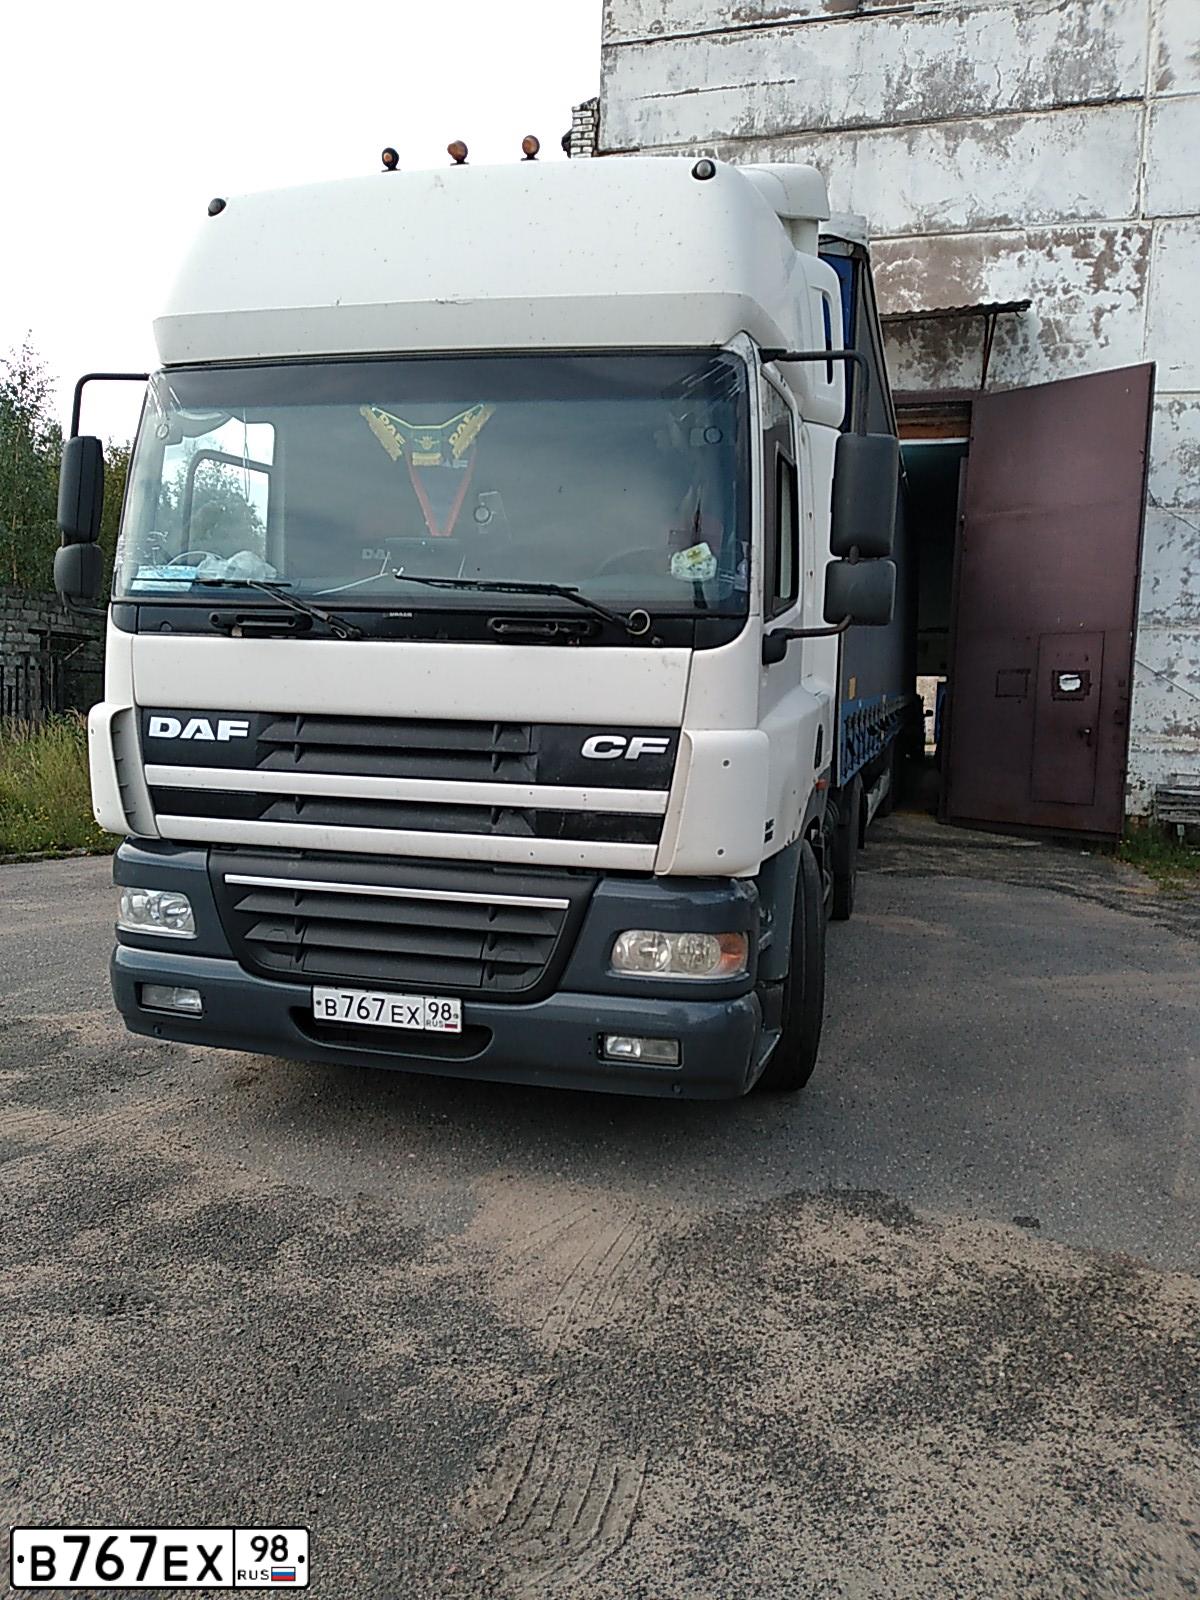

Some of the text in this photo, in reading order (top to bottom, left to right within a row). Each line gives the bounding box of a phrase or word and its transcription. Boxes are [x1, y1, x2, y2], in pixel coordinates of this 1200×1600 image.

[361, 548, 392, 560] DA
[148, 716, 250, 741] DAF
[581, 735, 670, 760] CF
[427, 1001, 452, 1021] 98
[426, 1019, 444, 1028] RUS
